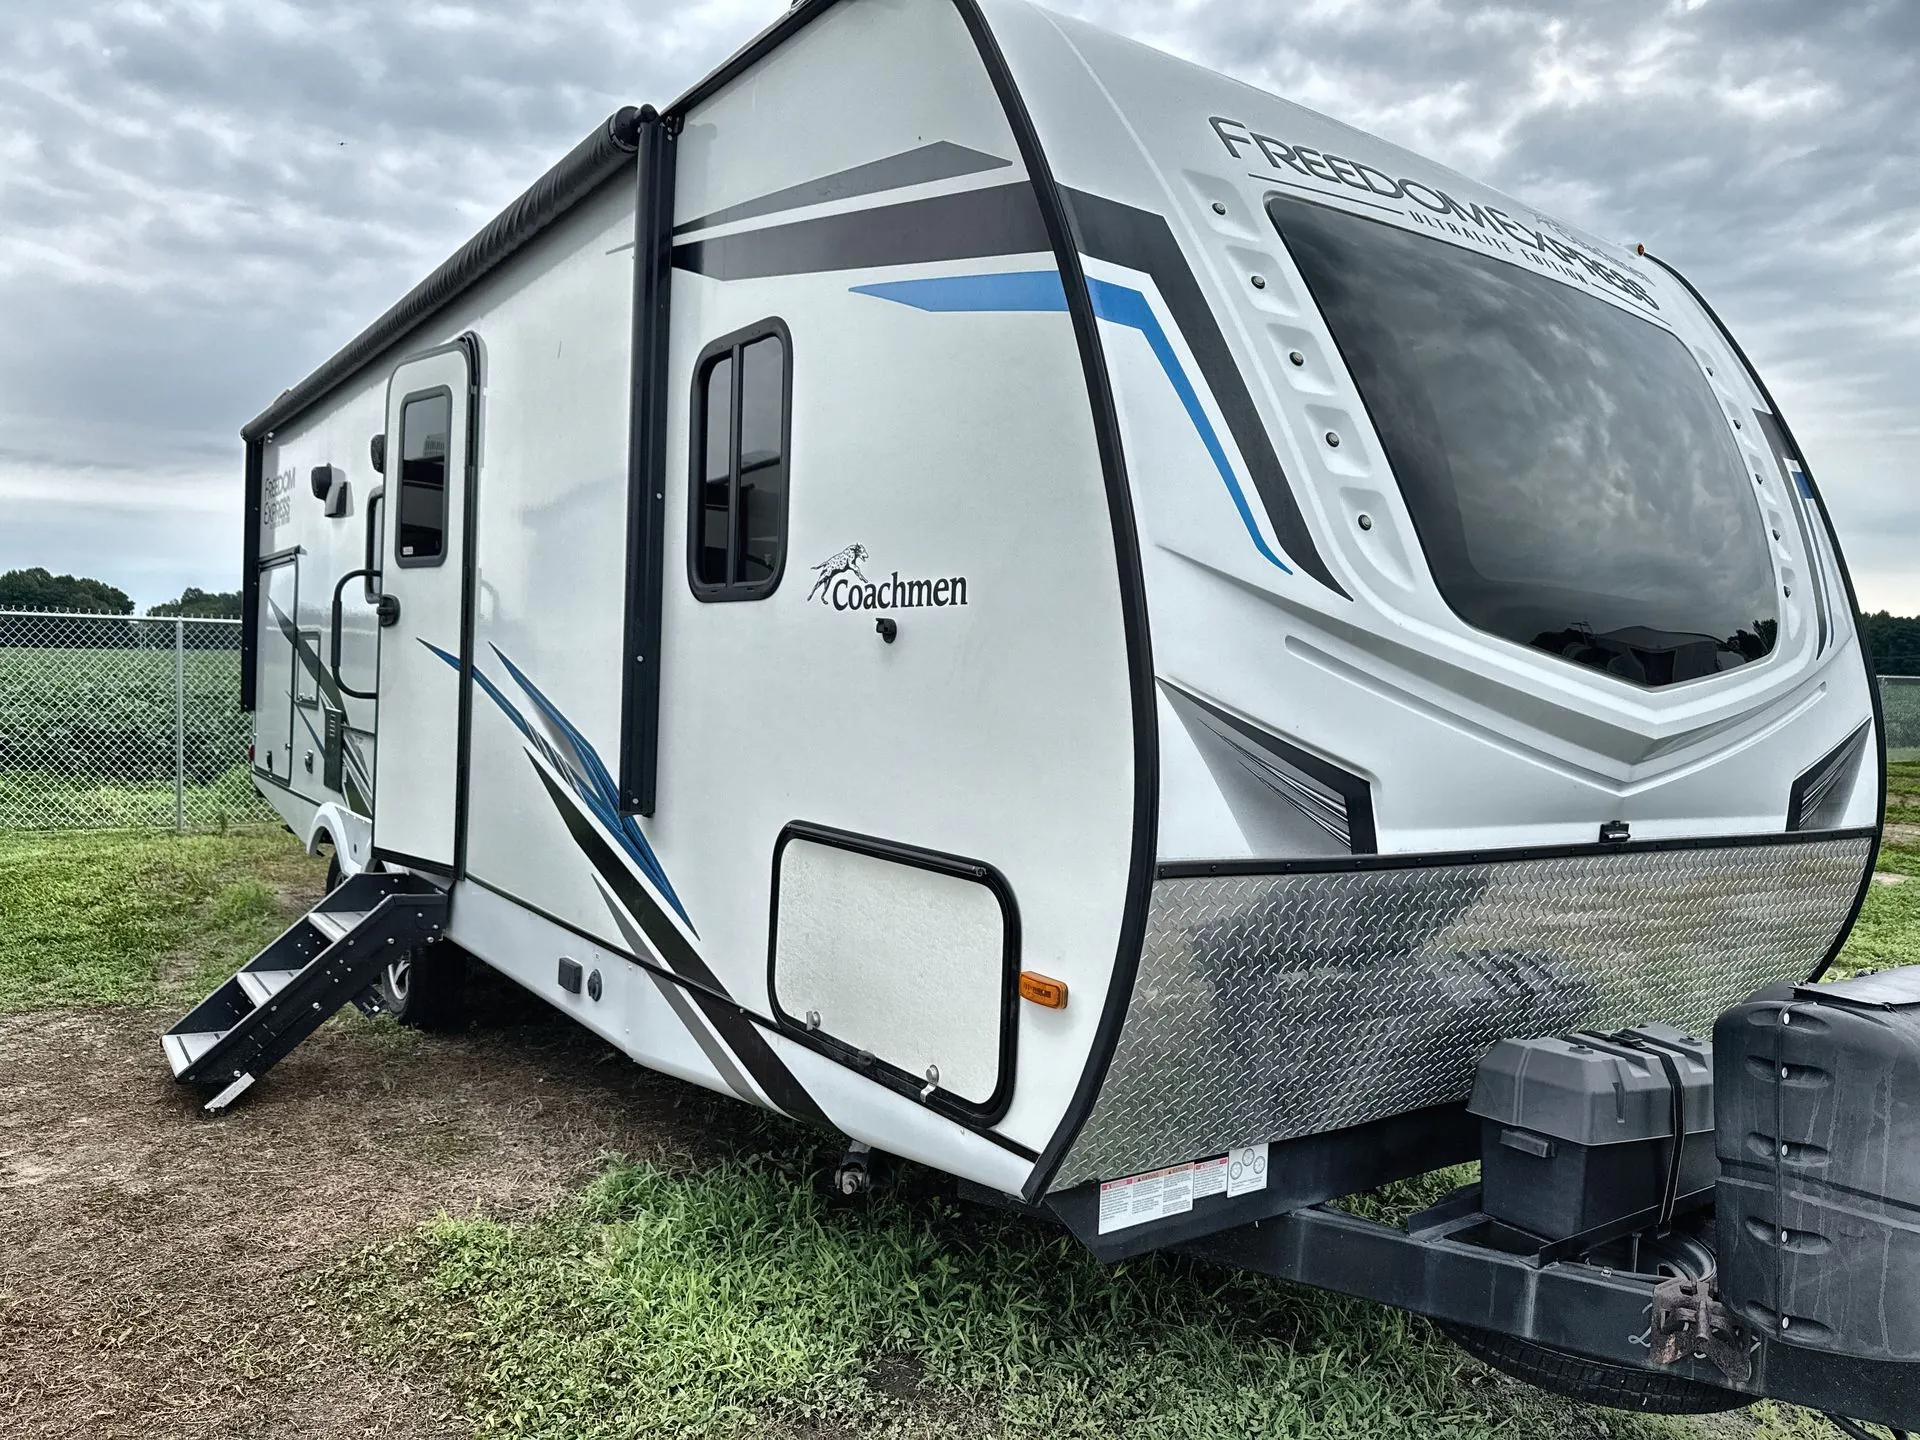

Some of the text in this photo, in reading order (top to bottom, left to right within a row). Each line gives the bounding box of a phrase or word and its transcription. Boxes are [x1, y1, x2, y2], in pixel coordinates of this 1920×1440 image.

[1520, 248, 1588, 285] EDITION
[264, 466, 296, 501] FREEDOM
[832, 571, 968, 611] Coachmen
